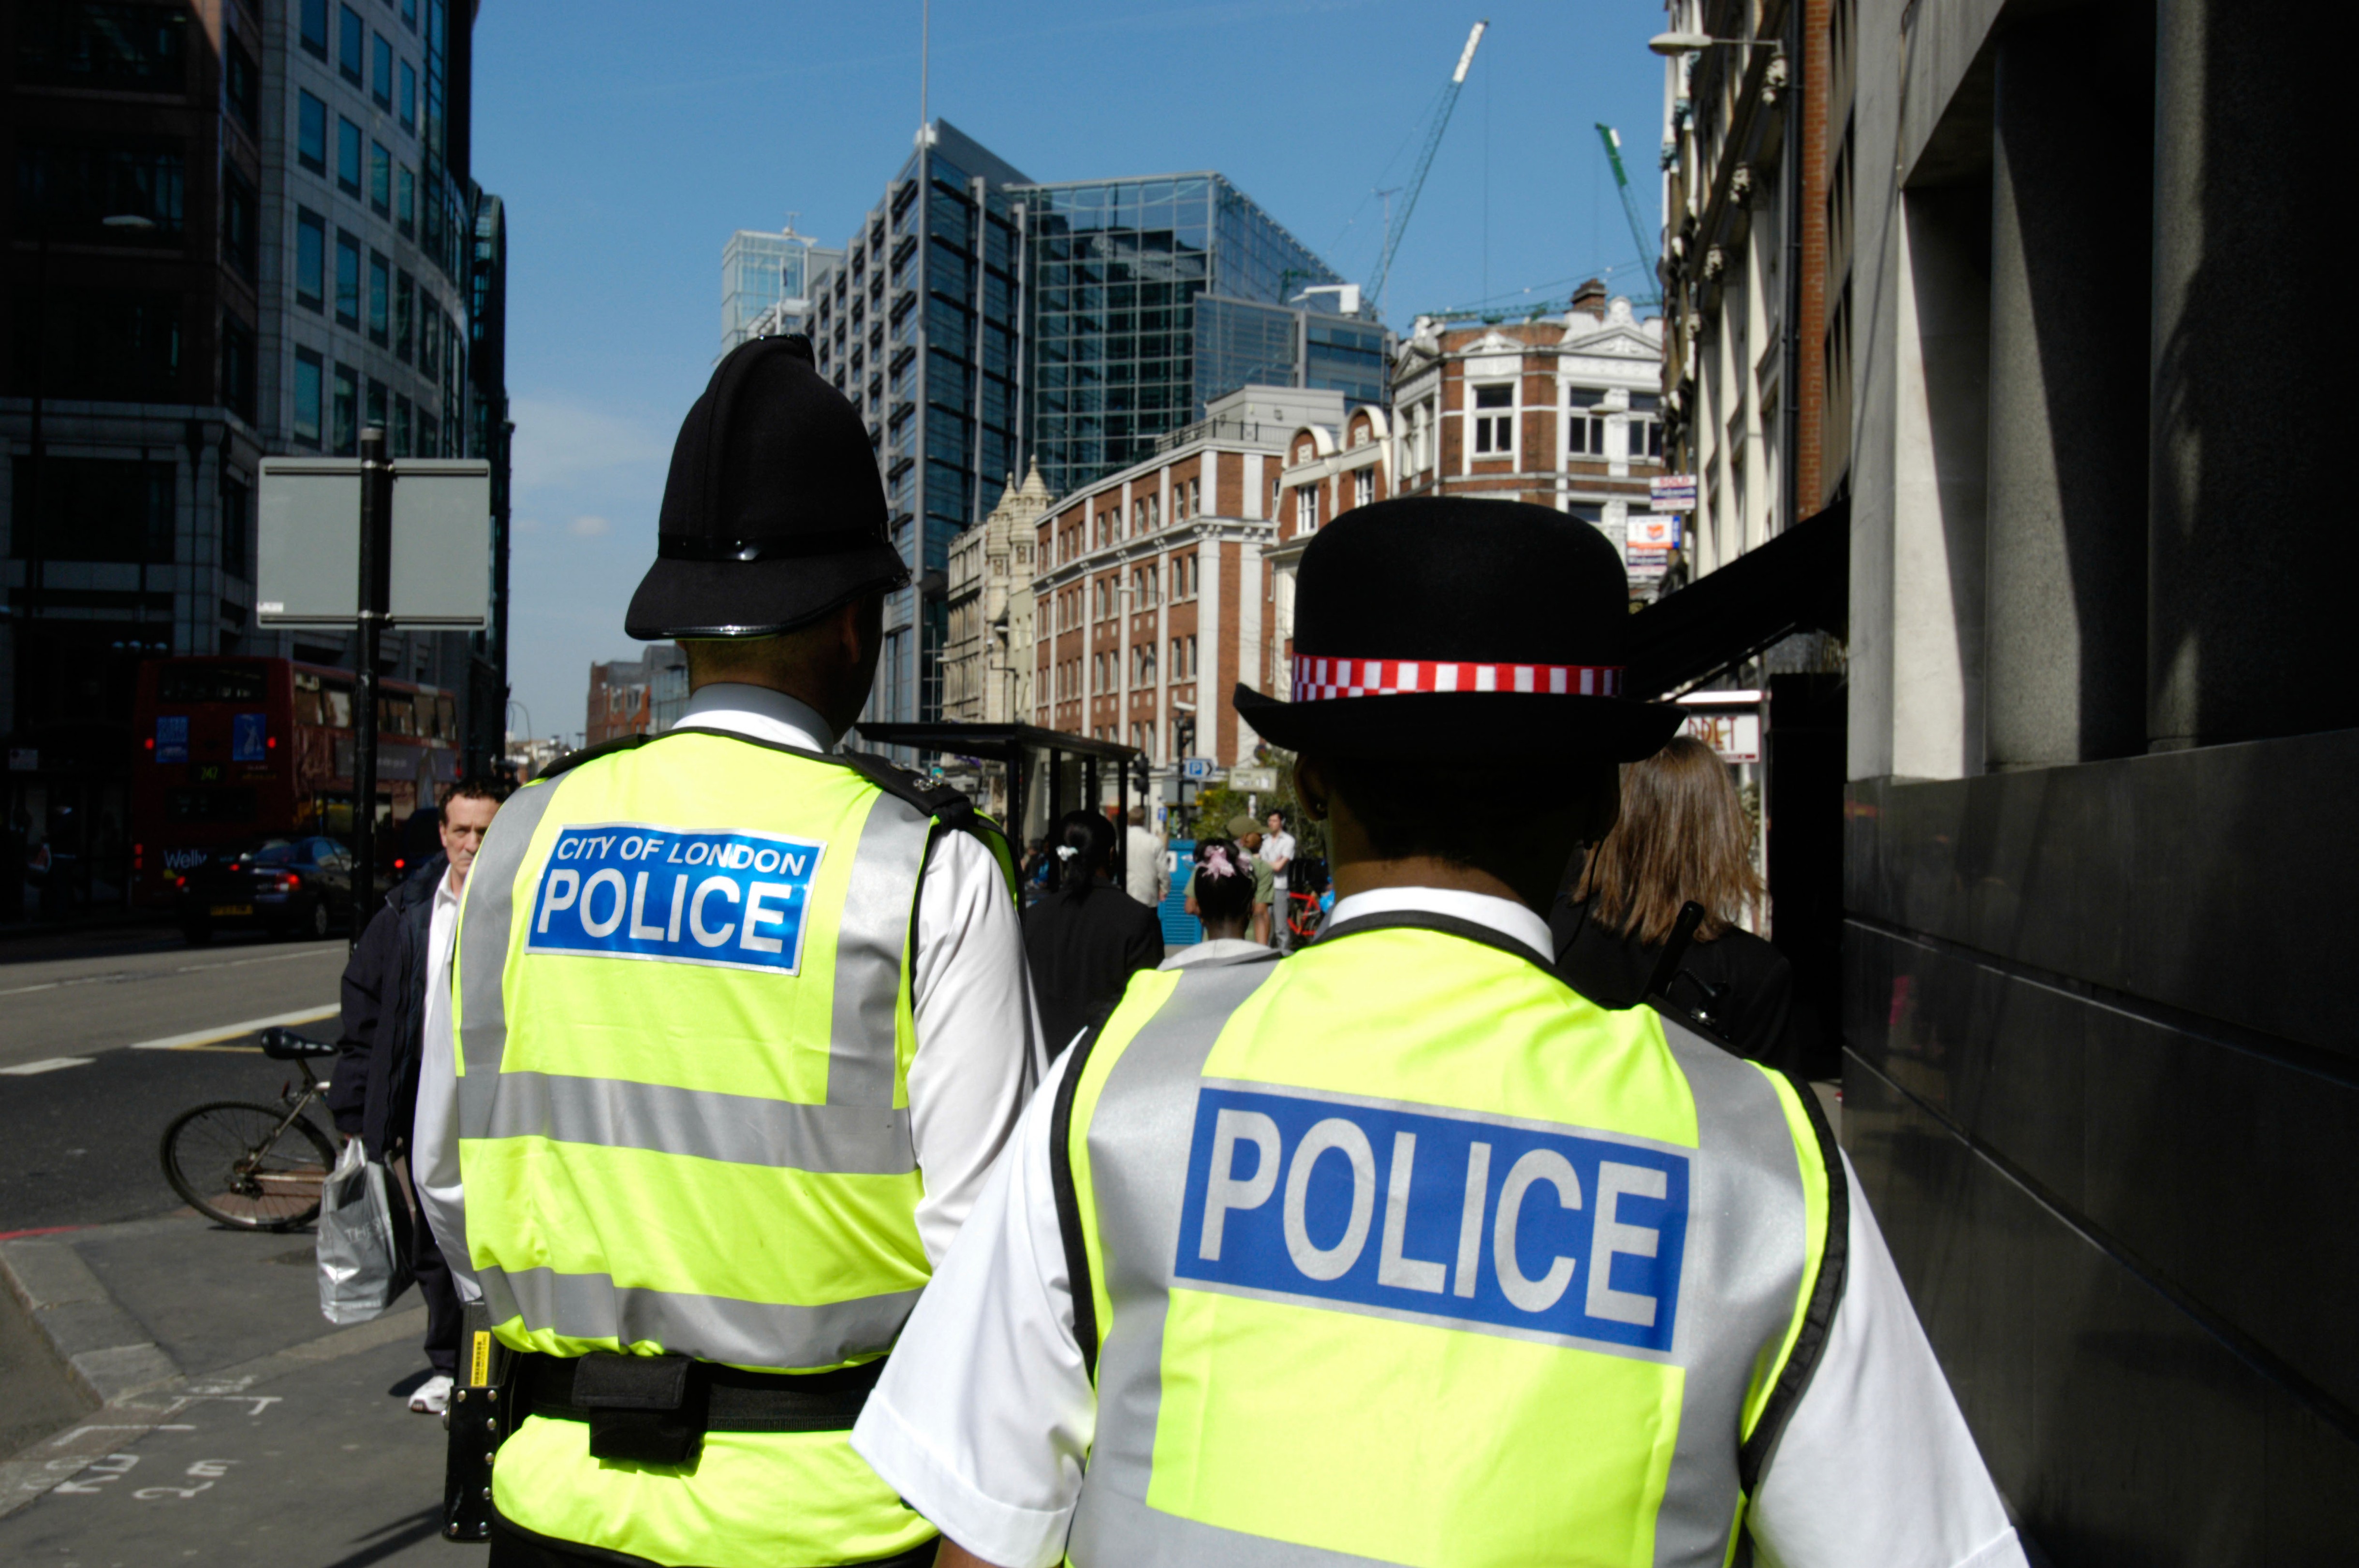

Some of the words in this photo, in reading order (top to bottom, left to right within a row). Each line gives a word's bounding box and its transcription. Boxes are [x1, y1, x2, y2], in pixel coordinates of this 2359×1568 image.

[557, 836, 616, 860] CITY
[620, 836, 664, 861] OF
[667, 842, 806, 876] LONDON
[537, 868, 792, 954] POLICE
[1198, 1108, 1668, 1327] POLICE
